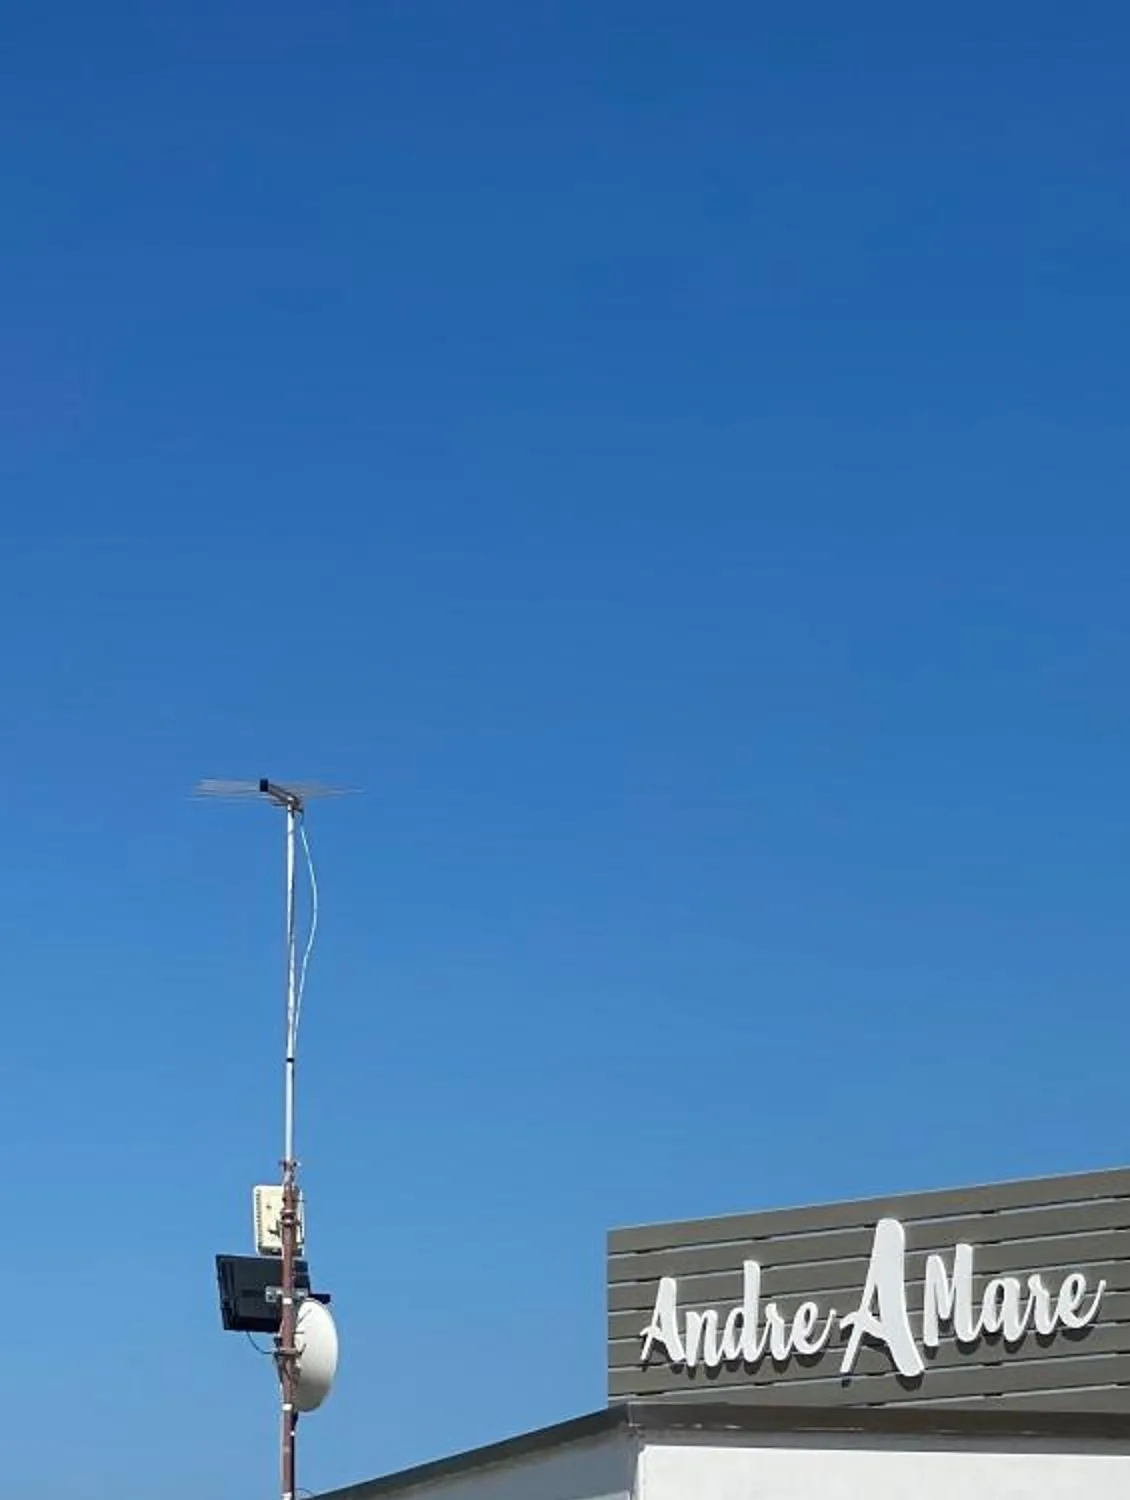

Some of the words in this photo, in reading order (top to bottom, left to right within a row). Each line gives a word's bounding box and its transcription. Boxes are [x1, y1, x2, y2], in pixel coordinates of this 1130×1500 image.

[639, 1260, 837, 1367] Andre
[839, 1217, 925, 1377] A
[923, 1243, 1107, 1347] Mare
